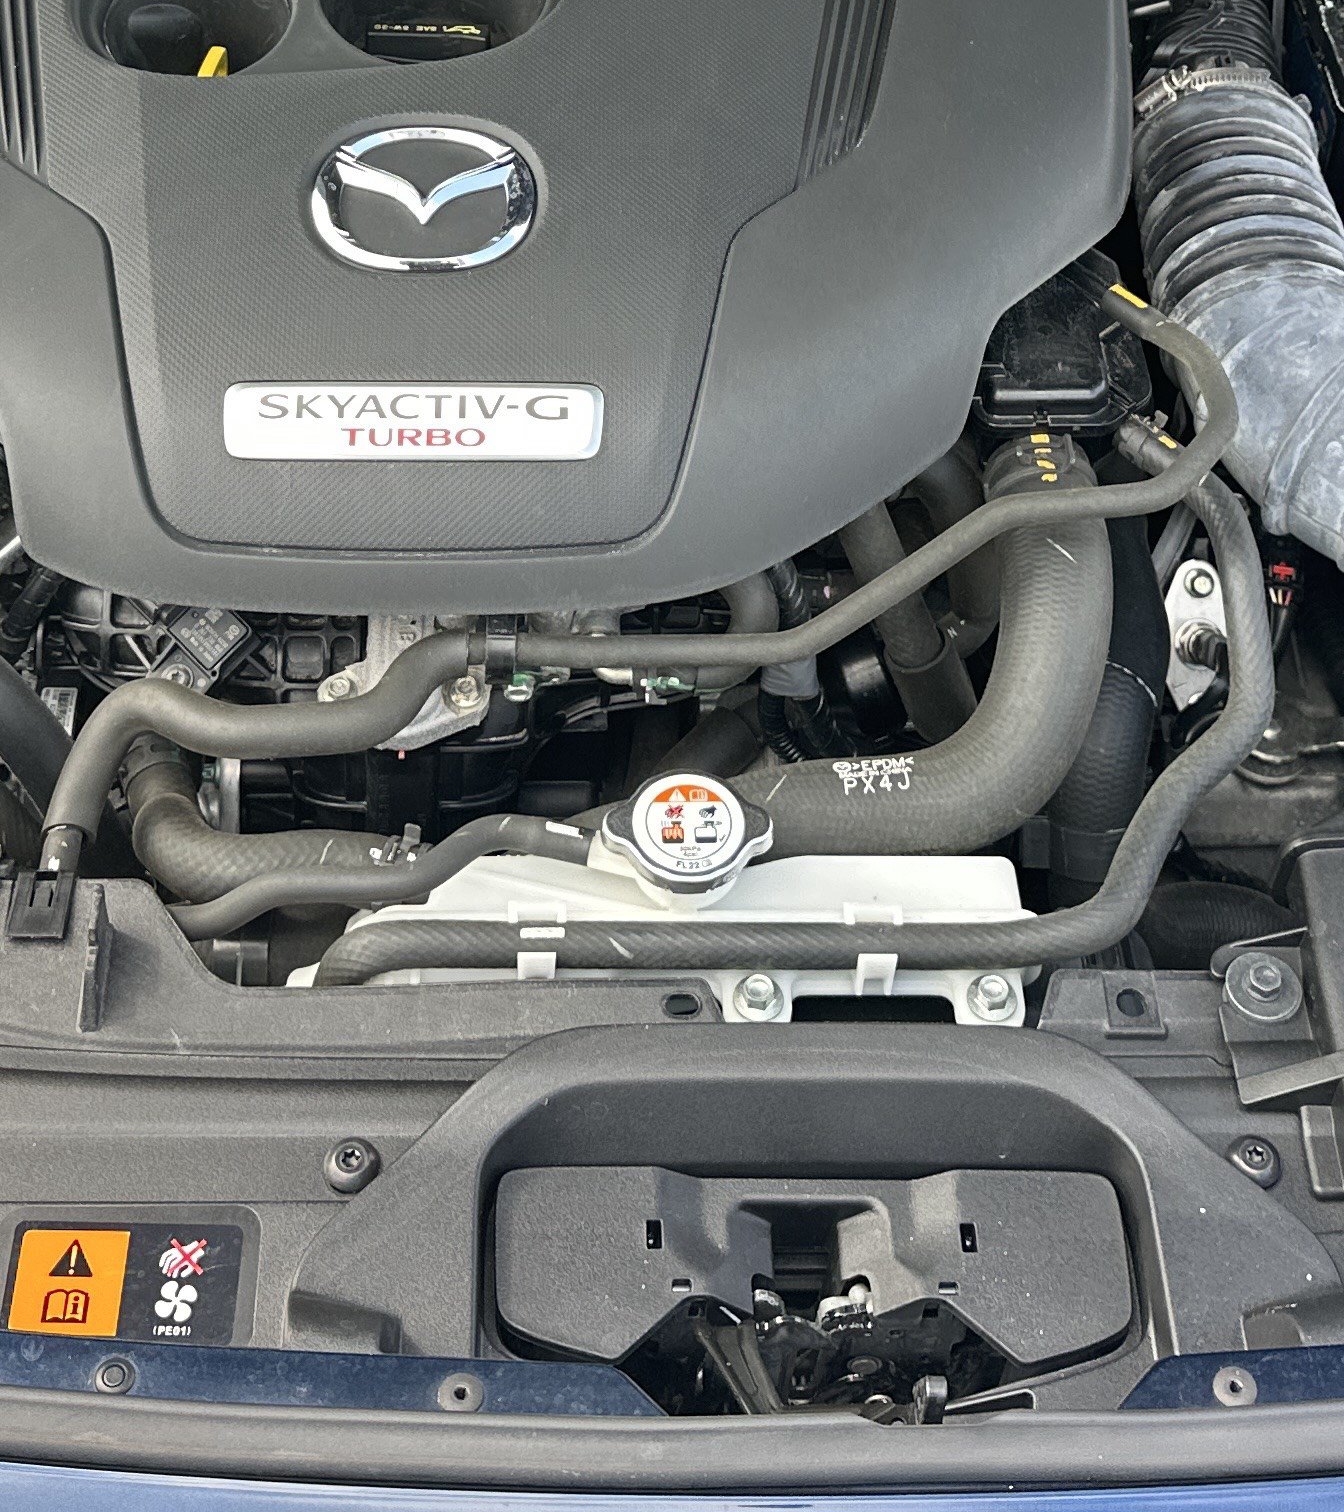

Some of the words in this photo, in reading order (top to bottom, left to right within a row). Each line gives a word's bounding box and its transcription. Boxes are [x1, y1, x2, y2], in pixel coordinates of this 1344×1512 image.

[258, 394, 570, 421] SKYACTIV-G
[341, 428, 486, 447] TURBO
[843, 771, 911, 796] PX4J
